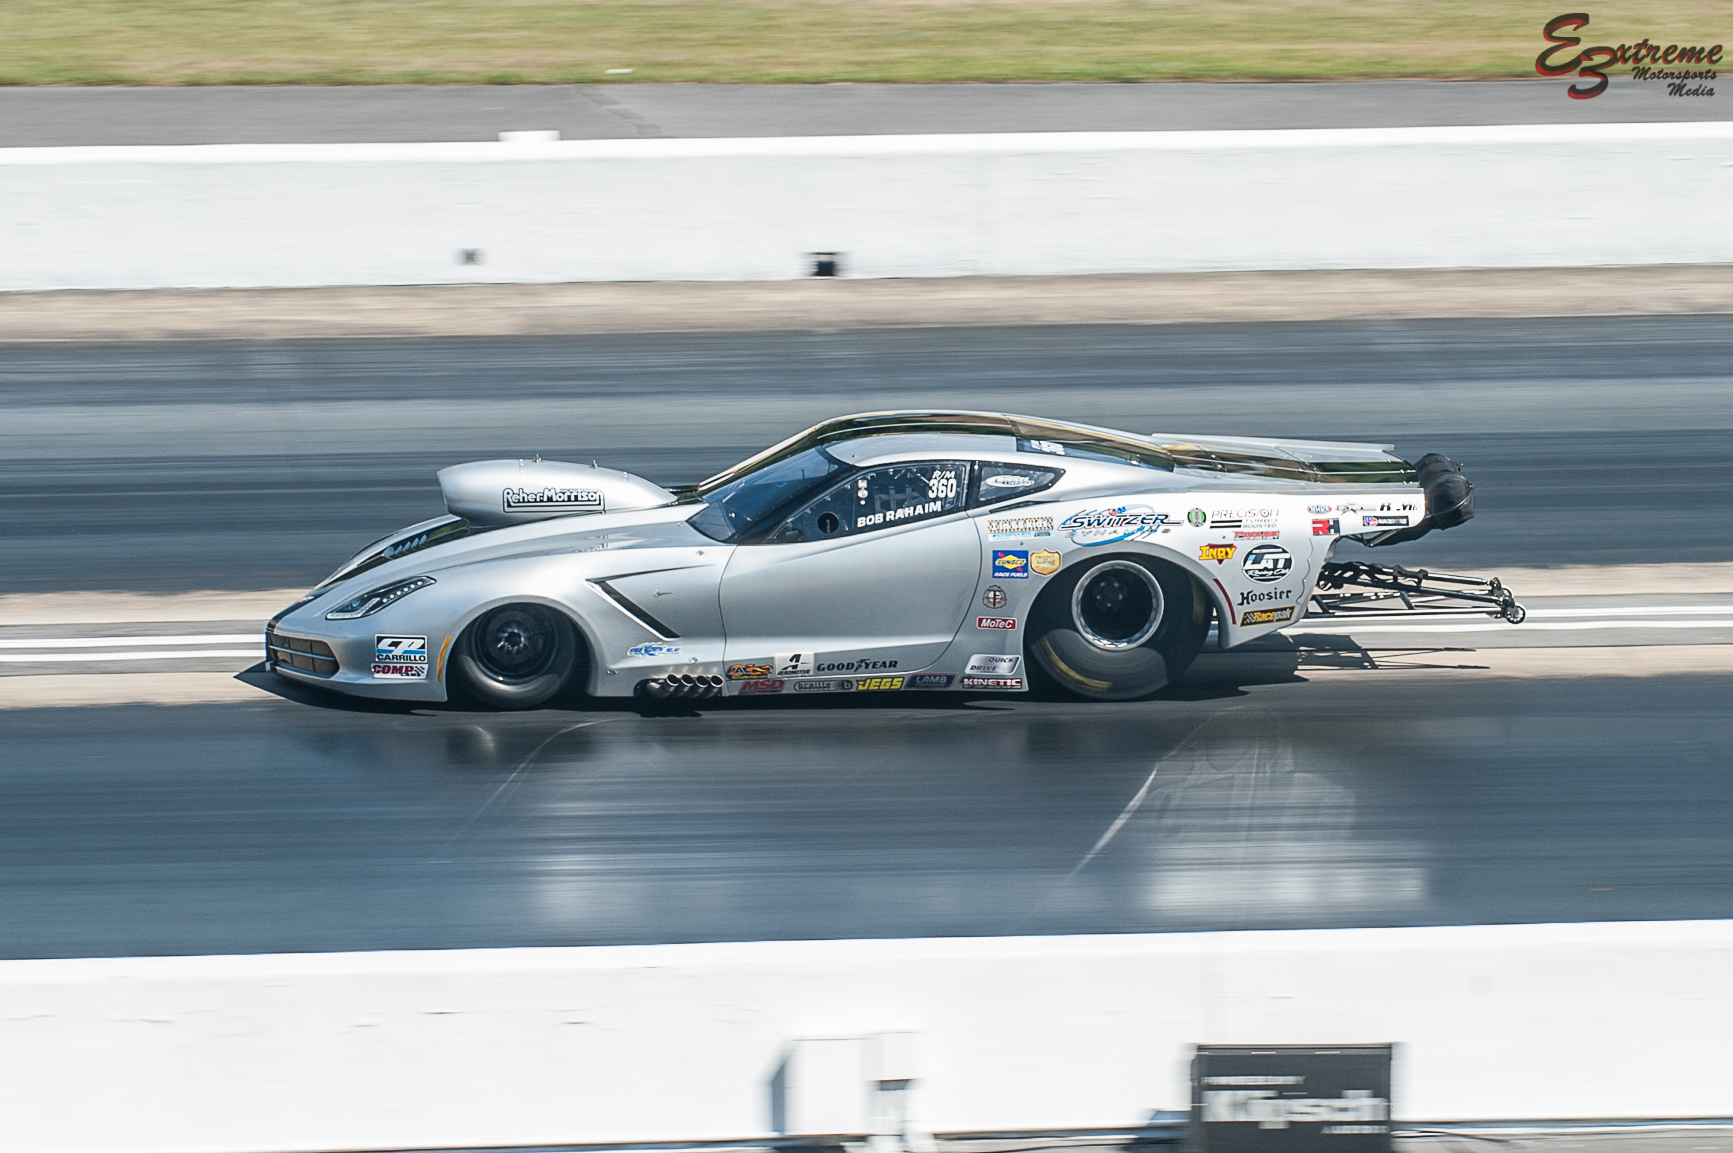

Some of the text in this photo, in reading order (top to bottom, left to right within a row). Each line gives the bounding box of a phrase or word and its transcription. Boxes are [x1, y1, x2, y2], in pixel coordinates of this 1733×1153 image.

[931, 469, 956, 480] R/M
[928, 478, 957, 498] 360
[857, 500, 942, 528] BOB RAHAIM
[1211, 508, 1280, 519] PRECISION
[1059, 513, 1184, 530] SWITZER
[1199, 545, 1237, 560] INDY
[1243, 552, 1291, 570] LAT
[1237, 587, 1292, 606] Hoosier
[1253, 608, 1293, 621] Racepak
[980, 618, 1013, 628] MoTeC
[377, 654, 426, 662] CARRILLO
[372, 664, 414, 675] COMP
[817, 659, 898, 672] GOODYEAR
[741, 679, 785, 691] MSD
[859, 678, 903, 691] JEGS
[915, 675, 947, 683] LAMB
[963, 678, 1021, 686] KINETIC
